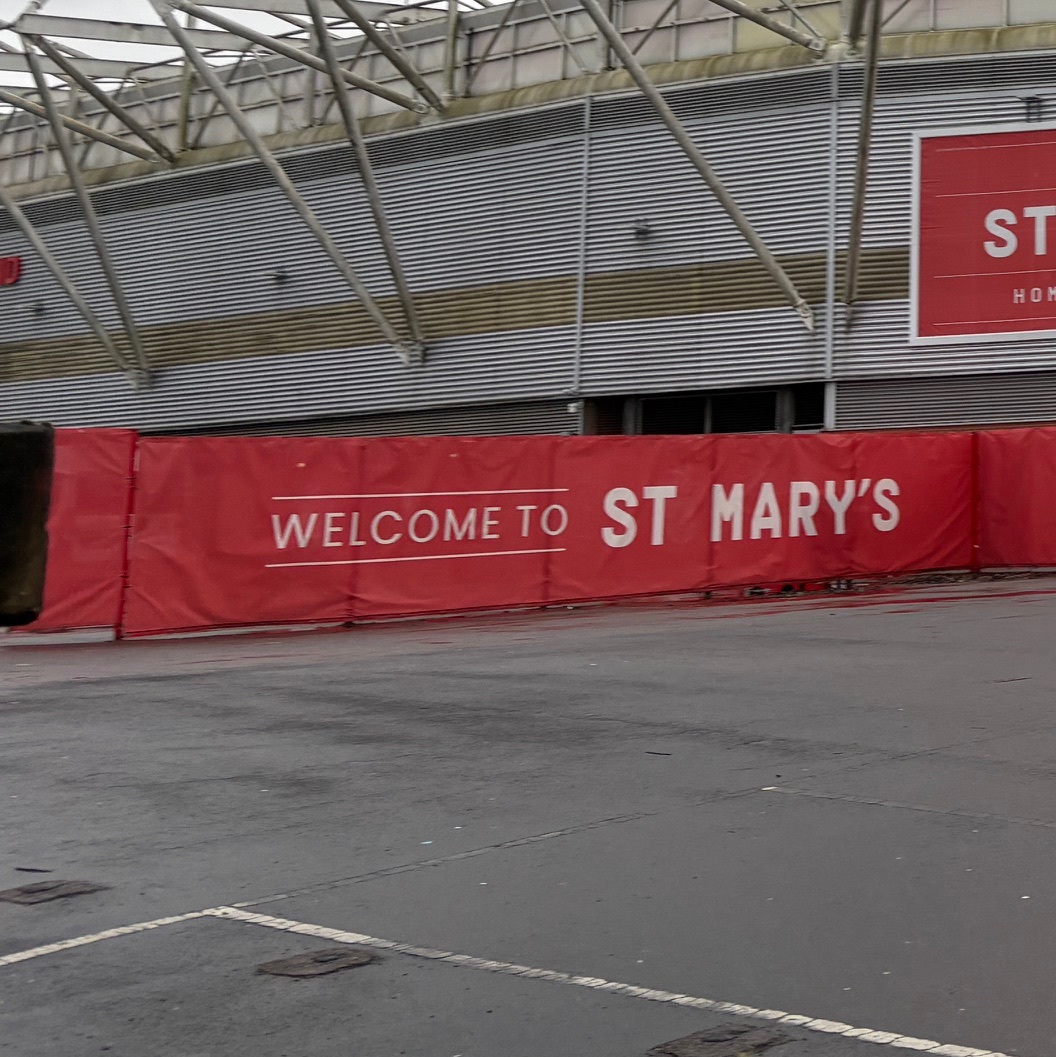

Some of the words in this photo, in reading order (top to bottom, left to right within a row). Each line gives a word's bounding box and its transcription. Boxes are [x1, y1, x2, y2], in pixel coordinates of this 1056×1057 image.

[271, 506, 501, 550] WELCOME
[515, 503, 569, 537] TO
[601, 485, 678, 548] ST
[710, 478, 900, 542] MARY'S
